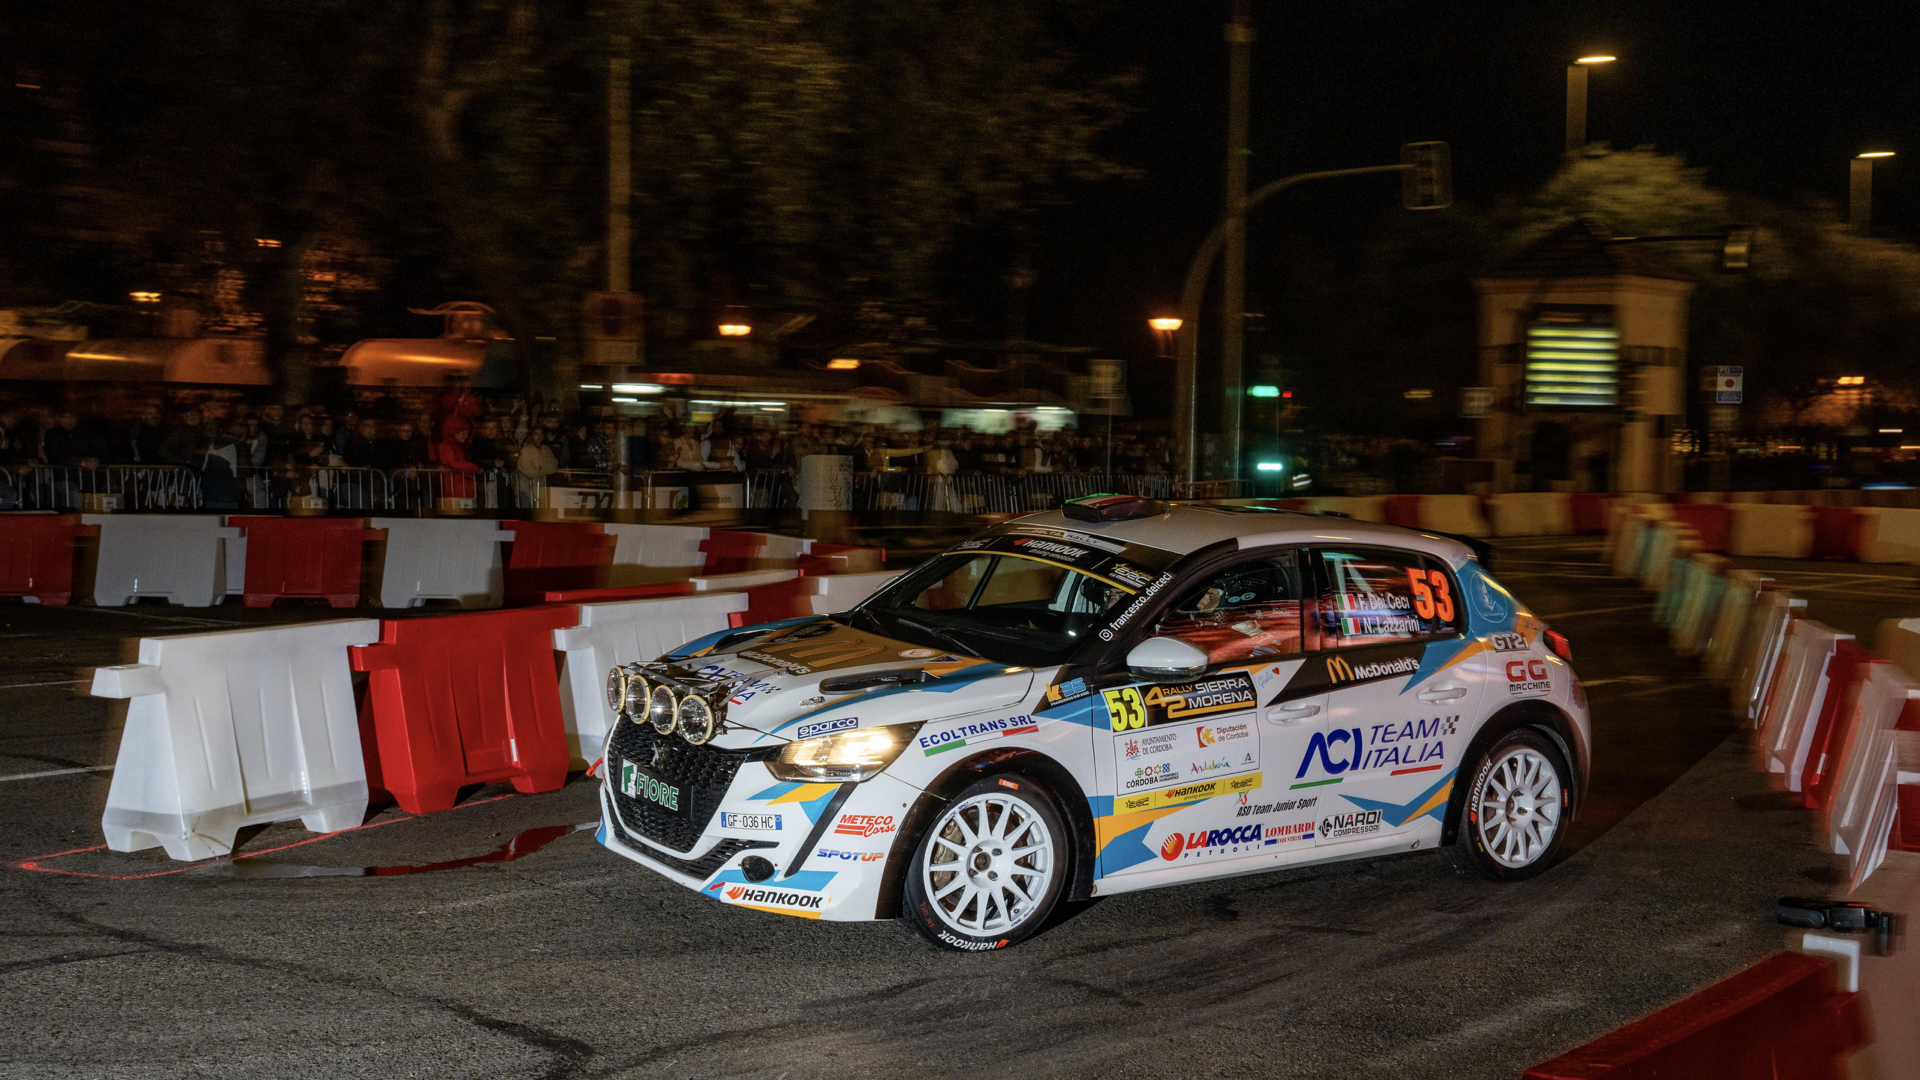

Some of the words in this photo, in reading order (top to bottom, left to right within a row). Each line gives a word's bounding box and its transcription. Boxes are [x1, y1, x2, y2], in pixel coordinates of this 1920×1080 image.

[1110, 572, 1173, 631] francesco_deiceci
[1386, 592, 1410, 610] Ceci
[1405, 566, 1455, 622] 53
[1363, 619, 1377, 634] N.
[1377, 614, 1420, 633] Lazzarini
[1354, 656, 1420, 680] McDonald's
[1506, 660, 1548, 682] GG
[1163, 685, 1193, 696] RALLY
[1195, 678, 1249, 694] SIERRA
[1509, 681, 1551, 692] MACCHINE
[1188, 690, 1254, 709] MORENA
[1104, 688, 1146, 732] 53
[799, 718, 857, 736] sparco
[919, 718, 1008, 749] ECOLTRANS
[1009, 713, 1037, 730] SRL
[1216, 723, 1248, 735] Diputación
[1141, 733, 1177, 746] AYUNTAMIENTO
[1218, 734, 1226, 742] de
[1226, 731, 1249, 742] Córdoba
[1142, 747, 1149, 756] DE
[1295, 728, 1363, 779] ACI
[1370, 717, 1441, 745] TEAM
[1362, 741, 1444, 770] ITALIA
[636, 772, 680, 811] FIORE
[1126, 776, 1159, 789] CÓRDOBA
[1236, 806, 1251, 818] ASD
[1251, 803, 1271, 815] Team
[1272, 801, 1296, 812] Junior
[1297, 796, 1318, 810] Sport
[742, 815, 760, 828] 036
[760, 816, 774, 829] HC
[839, 814, 894, 826] METECO
[1333, 810, 1382, 829] NARDI
[863, 822, 897, 838] Corse
[1264, 821, 1316, 838] LOMBARDI
[1333, 824, 1380, 837] COMPRESSORI
